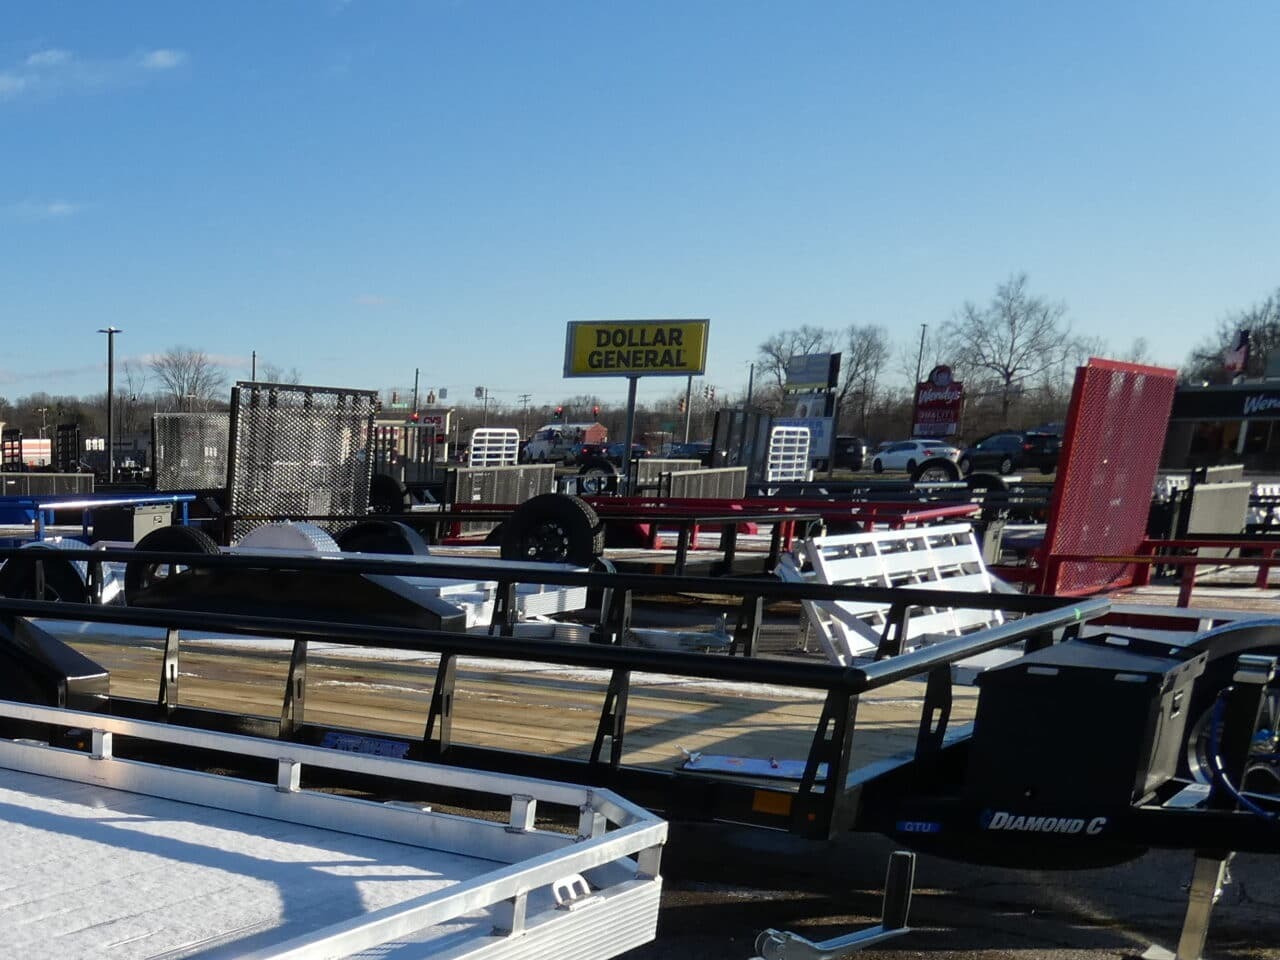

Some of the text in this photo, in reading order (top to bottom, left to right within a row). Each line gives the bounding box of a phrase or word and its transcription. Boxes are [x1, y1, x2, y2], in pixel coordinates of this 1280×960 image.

[596, 328, 682, 347] DOLLAR
[588, 350, 687, 368] GENERAL
[1243, 393, 1280, 415] Wen
[424, 416, 442, 424] CVS
[904, 822, 931, 833] GTU
[988, 811, 1107, 835] DIAMOND C
